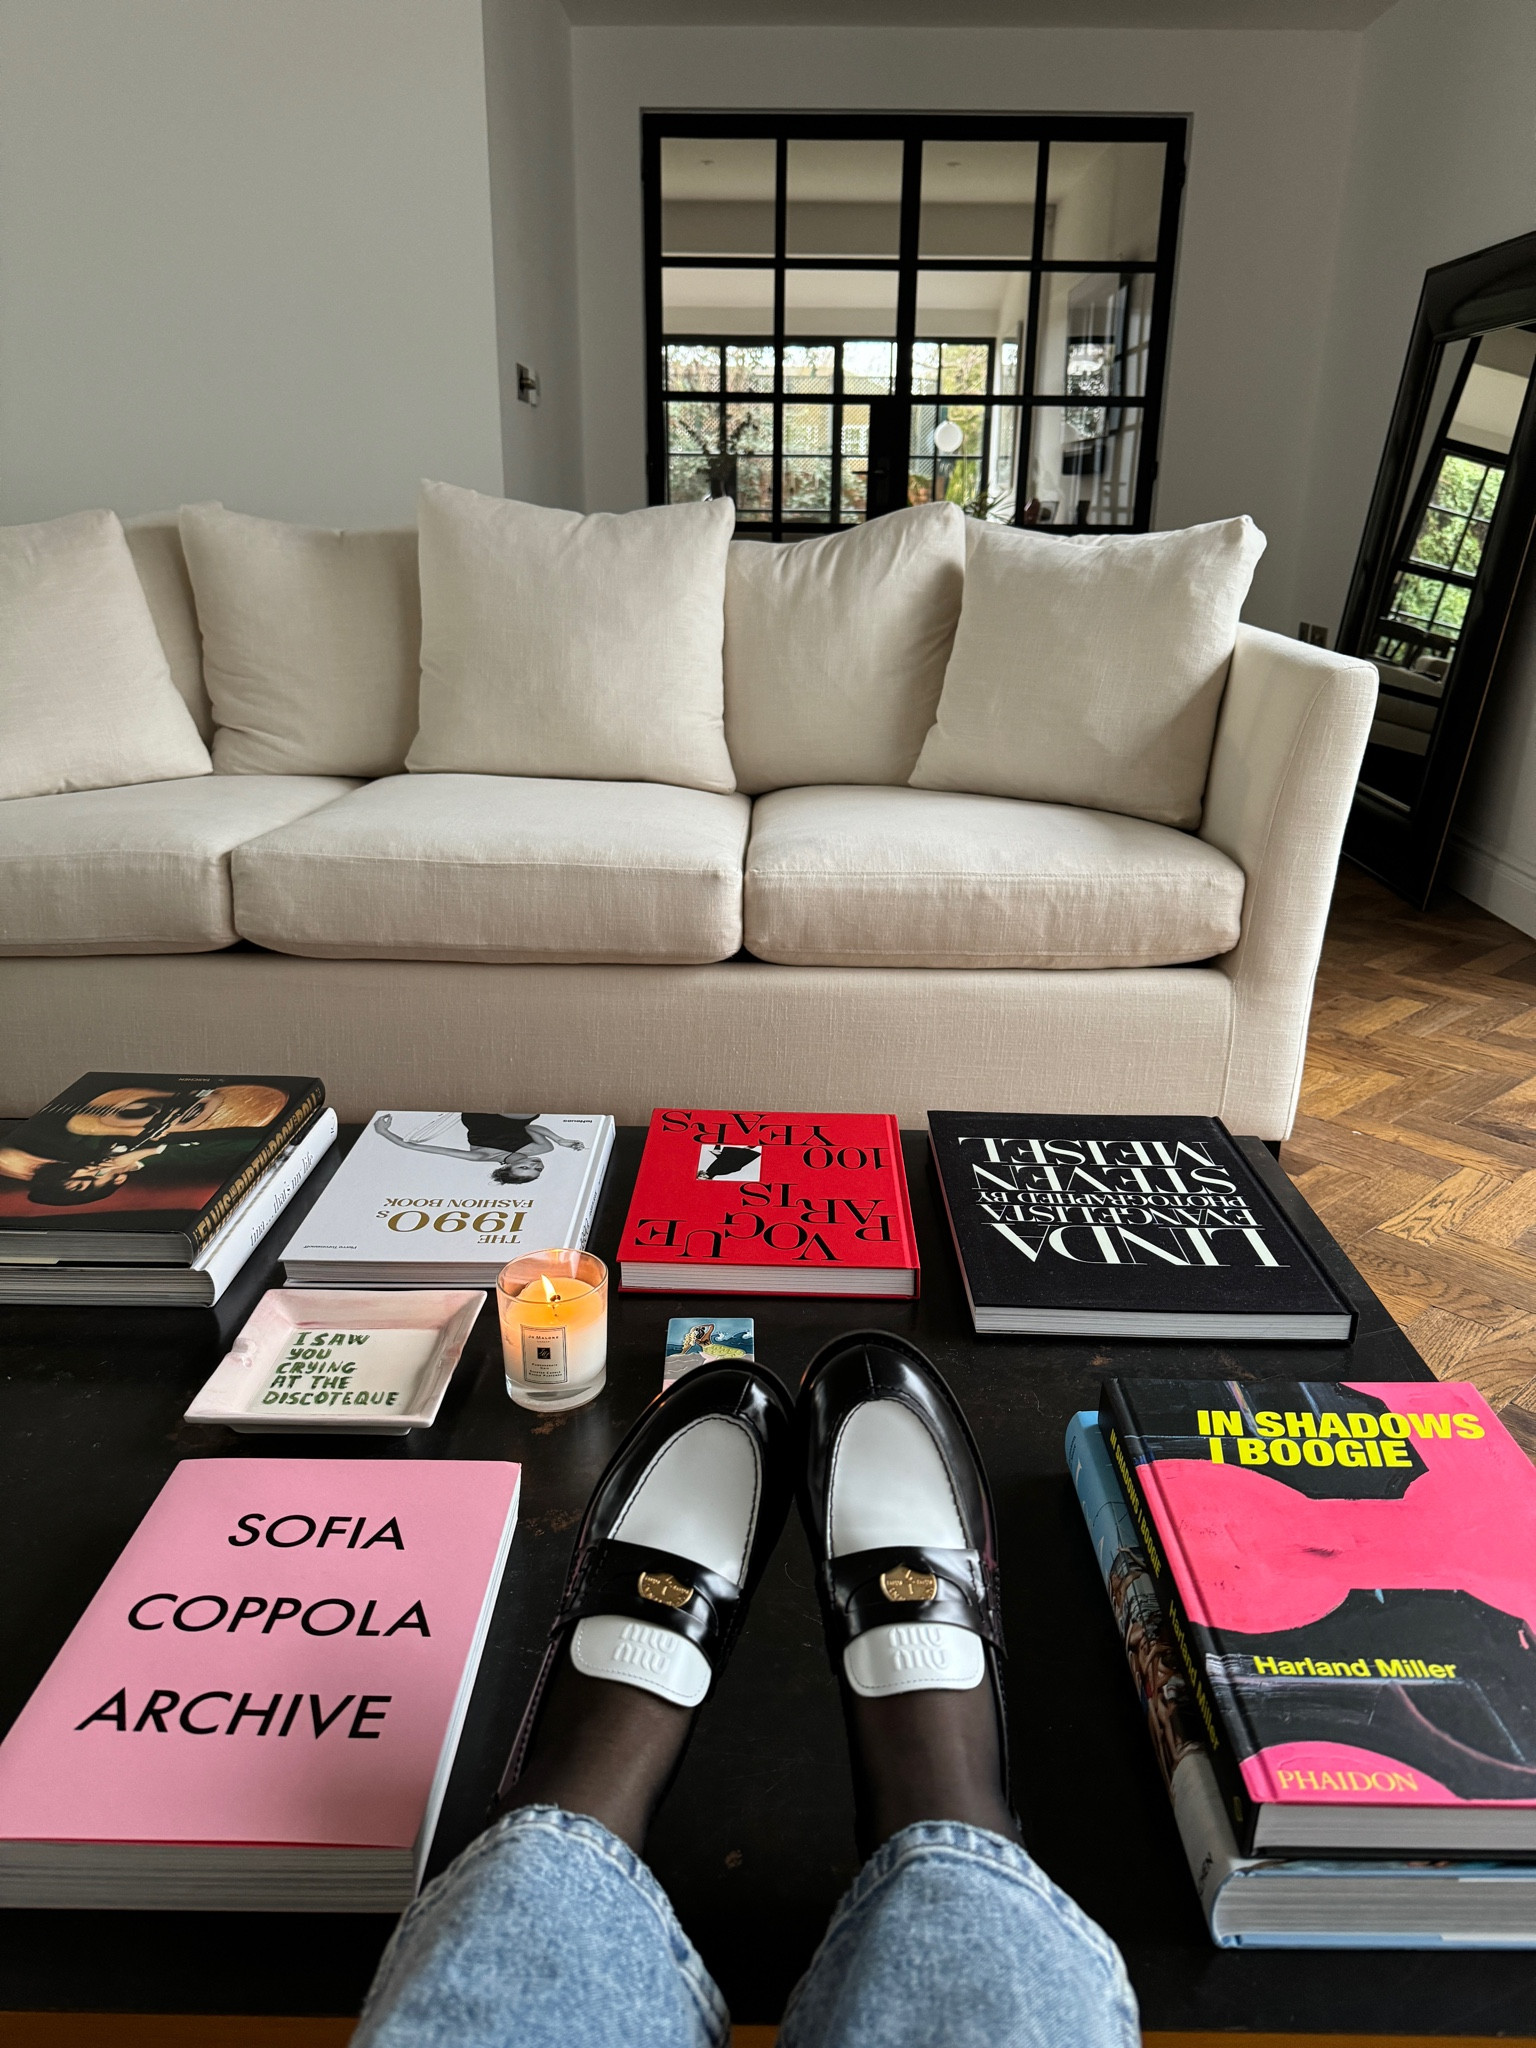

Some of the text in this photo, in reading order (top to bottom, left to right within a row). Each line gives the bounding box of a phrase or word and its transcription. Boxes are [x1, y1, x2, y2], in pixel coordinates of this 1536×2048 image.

[661, 1111, 841, 1146] YEARS
[802, 1146, 892, 1170] 100
[958, 1136, 1224, 1167] MEISEL
[972, 1163, 1237, 1194] STEVEN
[384, 1197, 535, 1208] FASHION BOOK
[739, 1182, 900, 1242] PARIS
[976, 1191, 1251, 1209] PHOTOGRAPHED BY
[376, 1210, 528, 1233] 1990s
[980, 1203, 1266, 1227] EVANGELISTA
[477, 1234, 521, 1244] THE
[634, 1211, 843, 1261] VOGUE
[990, 1223, 1290, 1268] LINDA
[293, 1332, 371, 1347] I SAW
[276, 1361, 358, 1374] CRYING
[286, 1348, 332, 1361] YOU
[270, 1375, 351, 1389] AT THE
[262, 1390, 400, 1406] DISCOTEQUE
[1197, 1409, 1486, 1440] IN SHADOWS
[1208, 1438, 1413, 1469] I BOOGIE
[1115, 1444, 1140, 1515] SHADOWS
[1140, 1516, 1162, 1579] BOOGIE
[227, 1513, 405, 1550] SOFIA
[128, 1593, 432, 1637] COPPOLA
[1169, 1599, 1220, 1750] Harland Miller
[1253, 1654, 1457, 1679] Harland Miller
[74, 1687, 393, 1740] ARCHIVE
[1277, 1769, 1419, 1793] PHAIDON
